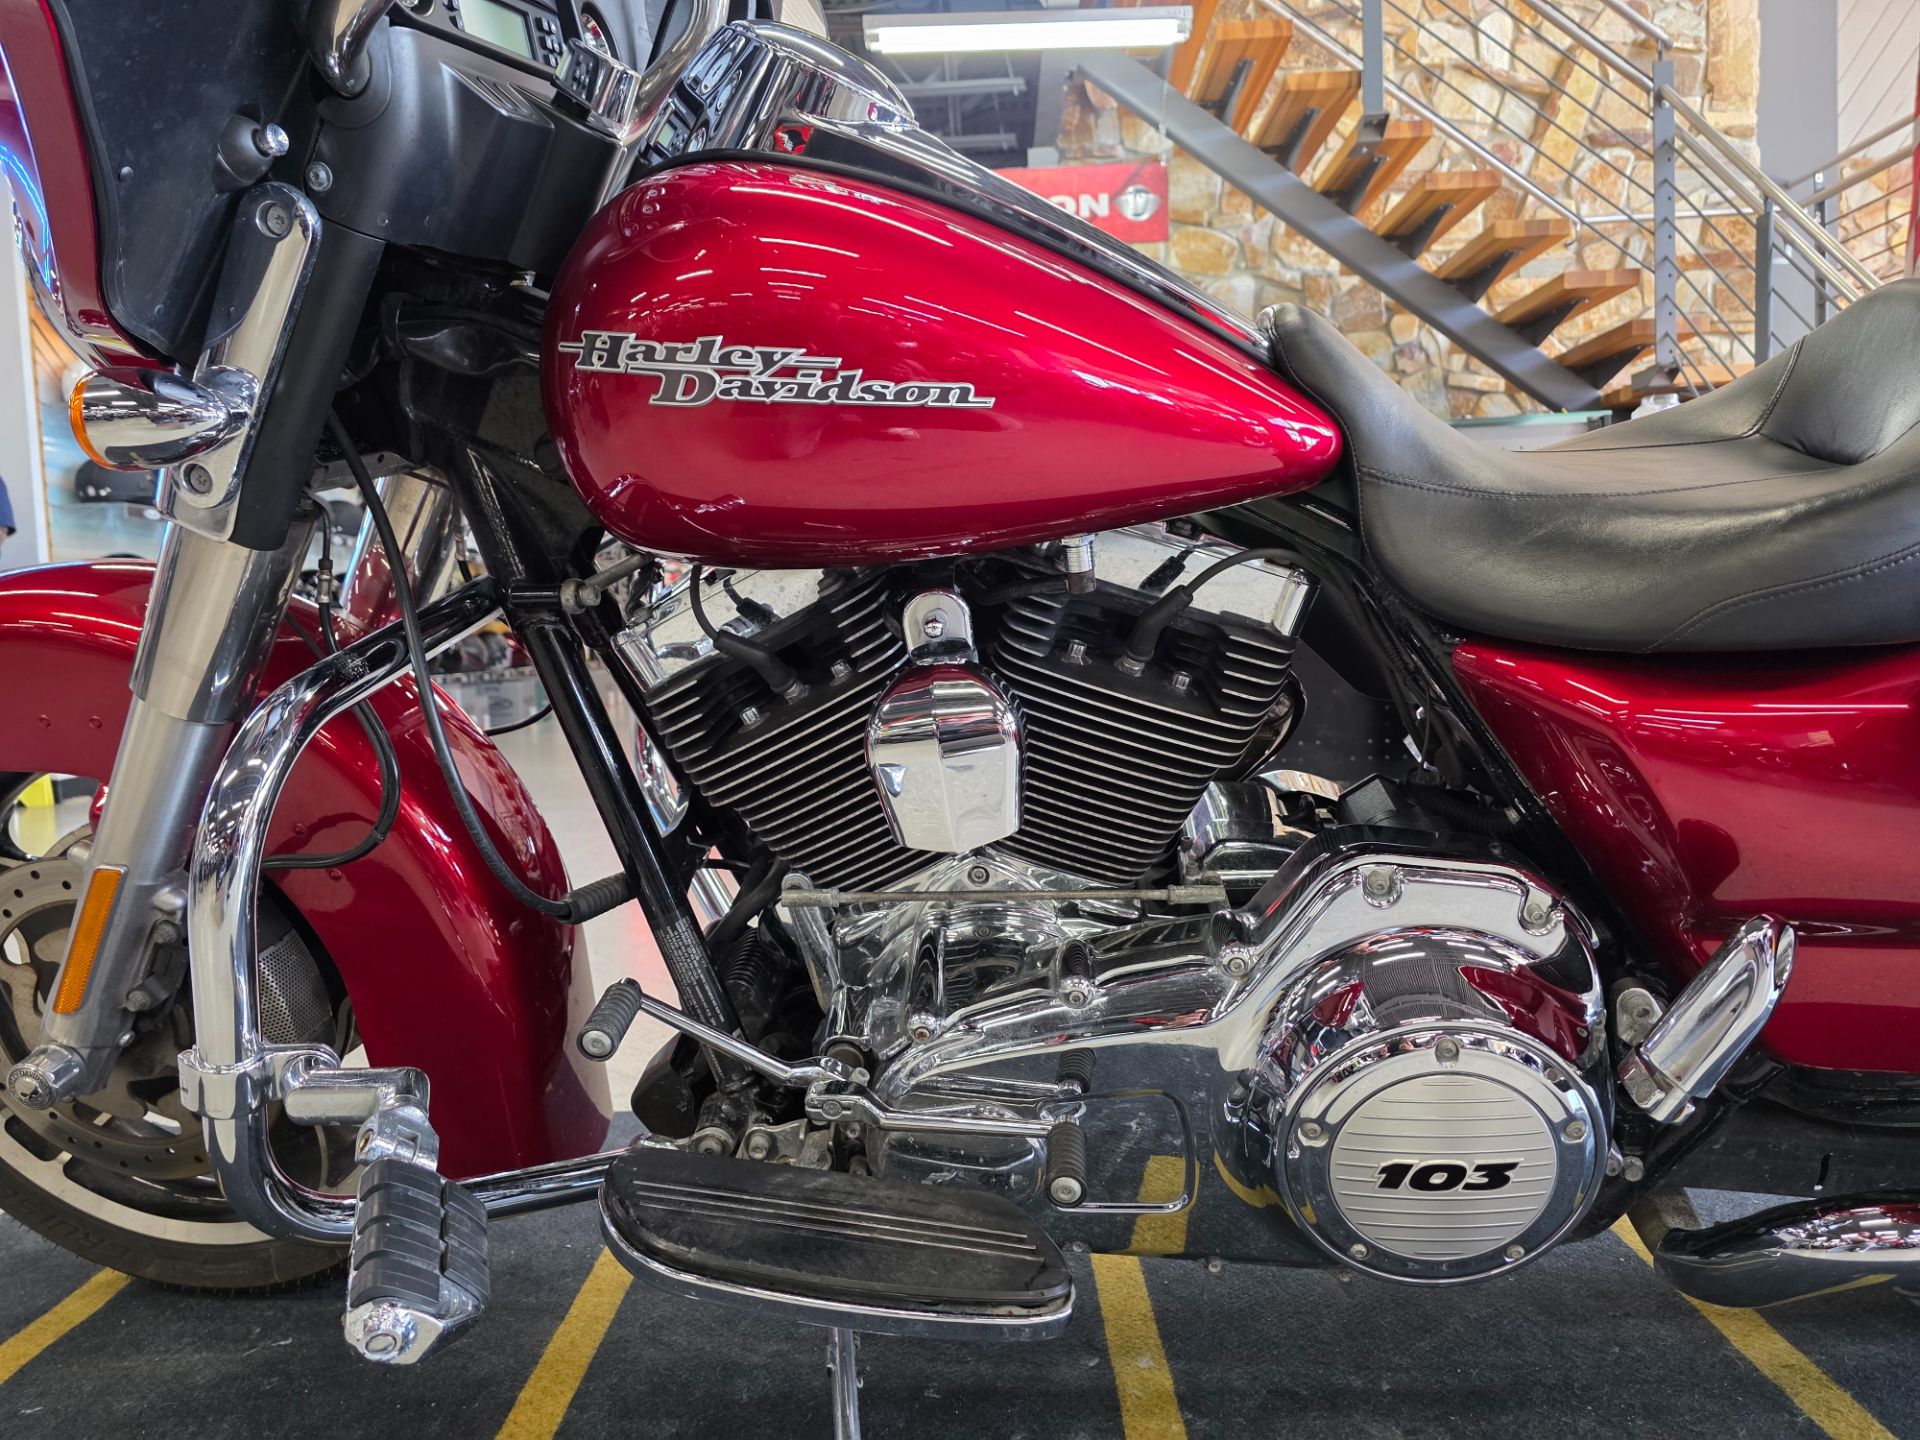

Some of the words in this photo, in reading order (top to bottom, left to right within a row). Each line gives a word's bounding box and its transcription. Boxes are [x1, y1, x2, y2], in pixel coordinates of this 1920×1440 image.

[558, 330, 843, 376] Harley
[627, 366, 996, 408] Davidson
[1375, 1159, 1523, 1192] 103
